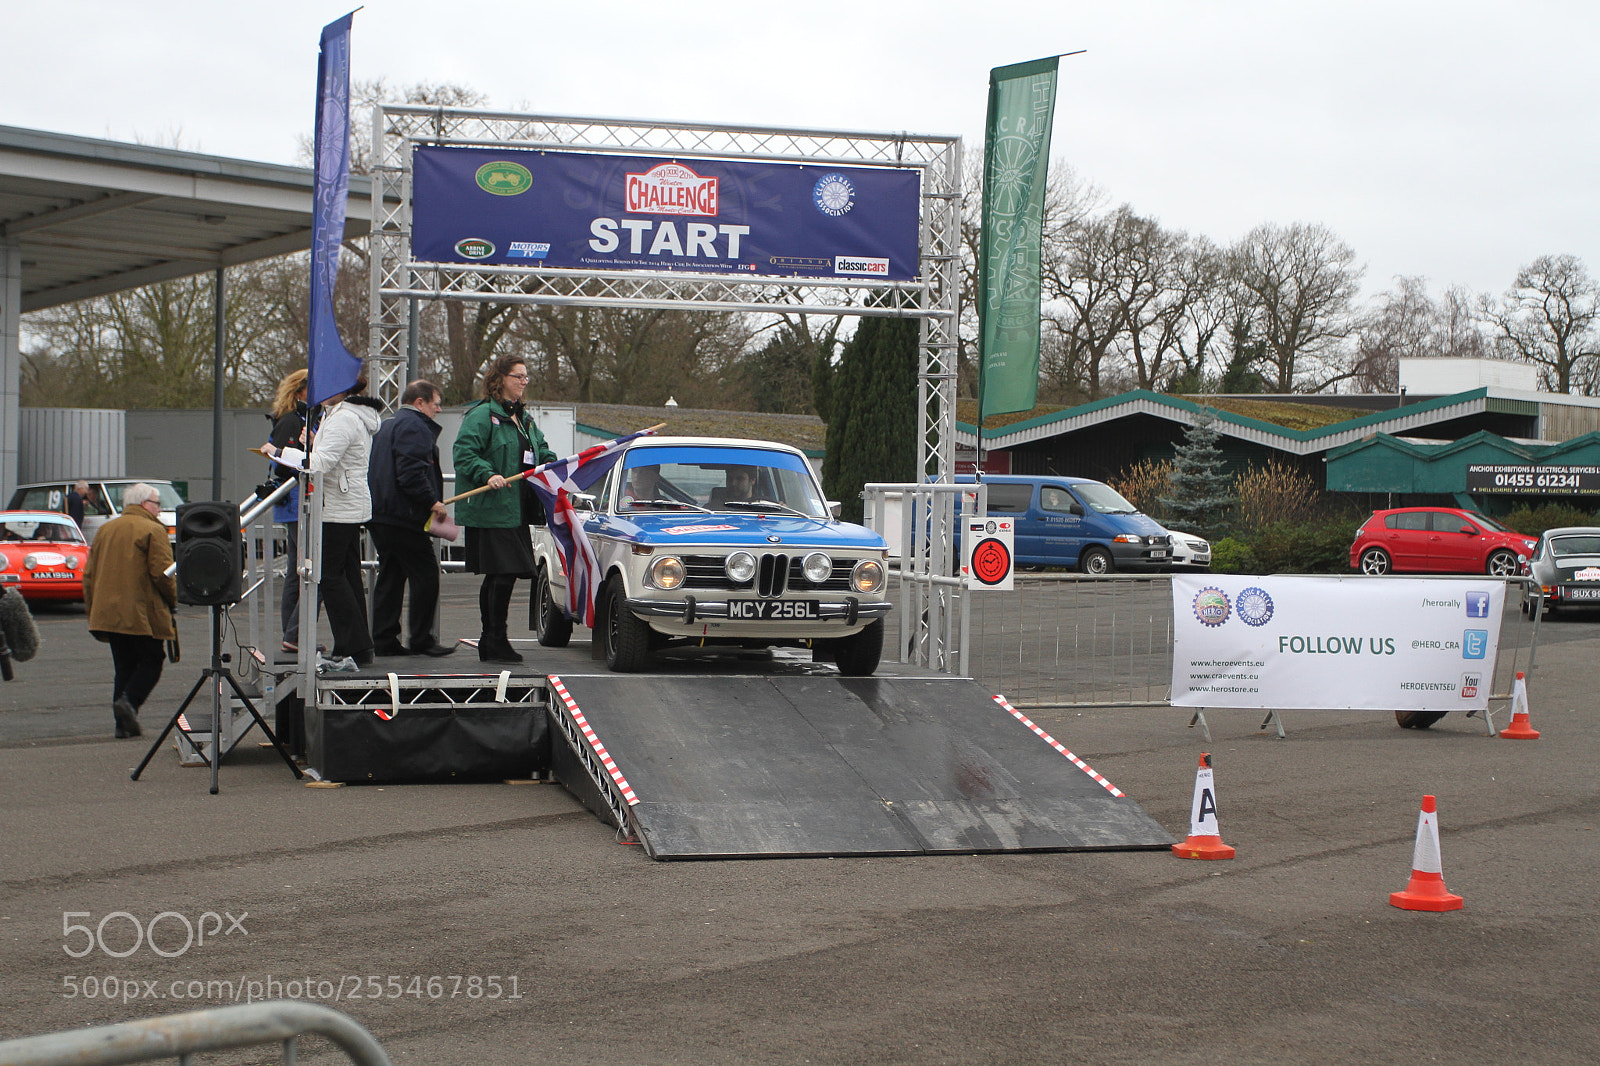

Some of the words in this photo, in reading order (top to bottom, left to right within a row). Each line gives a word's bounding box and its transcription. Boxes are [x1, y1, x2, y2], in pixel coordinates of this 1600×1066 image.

[628, 176, 716, 215] CHALLENGE
[816, 199, 855, 217] ASSOCIATION
[588, 217, 750, 259] START
[510, 243, 549, 251] MOTORS
[1469, 465, 1494, 473] ANCHOR
[1494, 465, 1530, 474] EXHIBITIONS
[1536, 466, 1569, 474] ELECTRICAL
[1569, 466, 1596, 474] SERVICES
[1495, 474, 1534, 487] 01455
[1537, 474, 1580, 488] 612341
[48, 489, 61, 510] 19
[1573, 589, 1591, 598] SUX
[730, 601, 766, 618] MCY
[771, 601, 817, 618] 256L
[1422, 598, 1461, 609] /herorally
[1279, 636, 1364, 655] FOLLOW
[1370, 637, 1395, 655] US
[1411, 640, 1460, 651] @HERO_CRA
[1190, 660, 1265, 668] www.heroevents.eu
[1400, 682, 1457, 691] HEROEVENTSEU
[1464, 675, 1479, 687] You
[1188, 685, 1259, 693] www.herostore.eu
[1198, 788, 1218, 823] A
